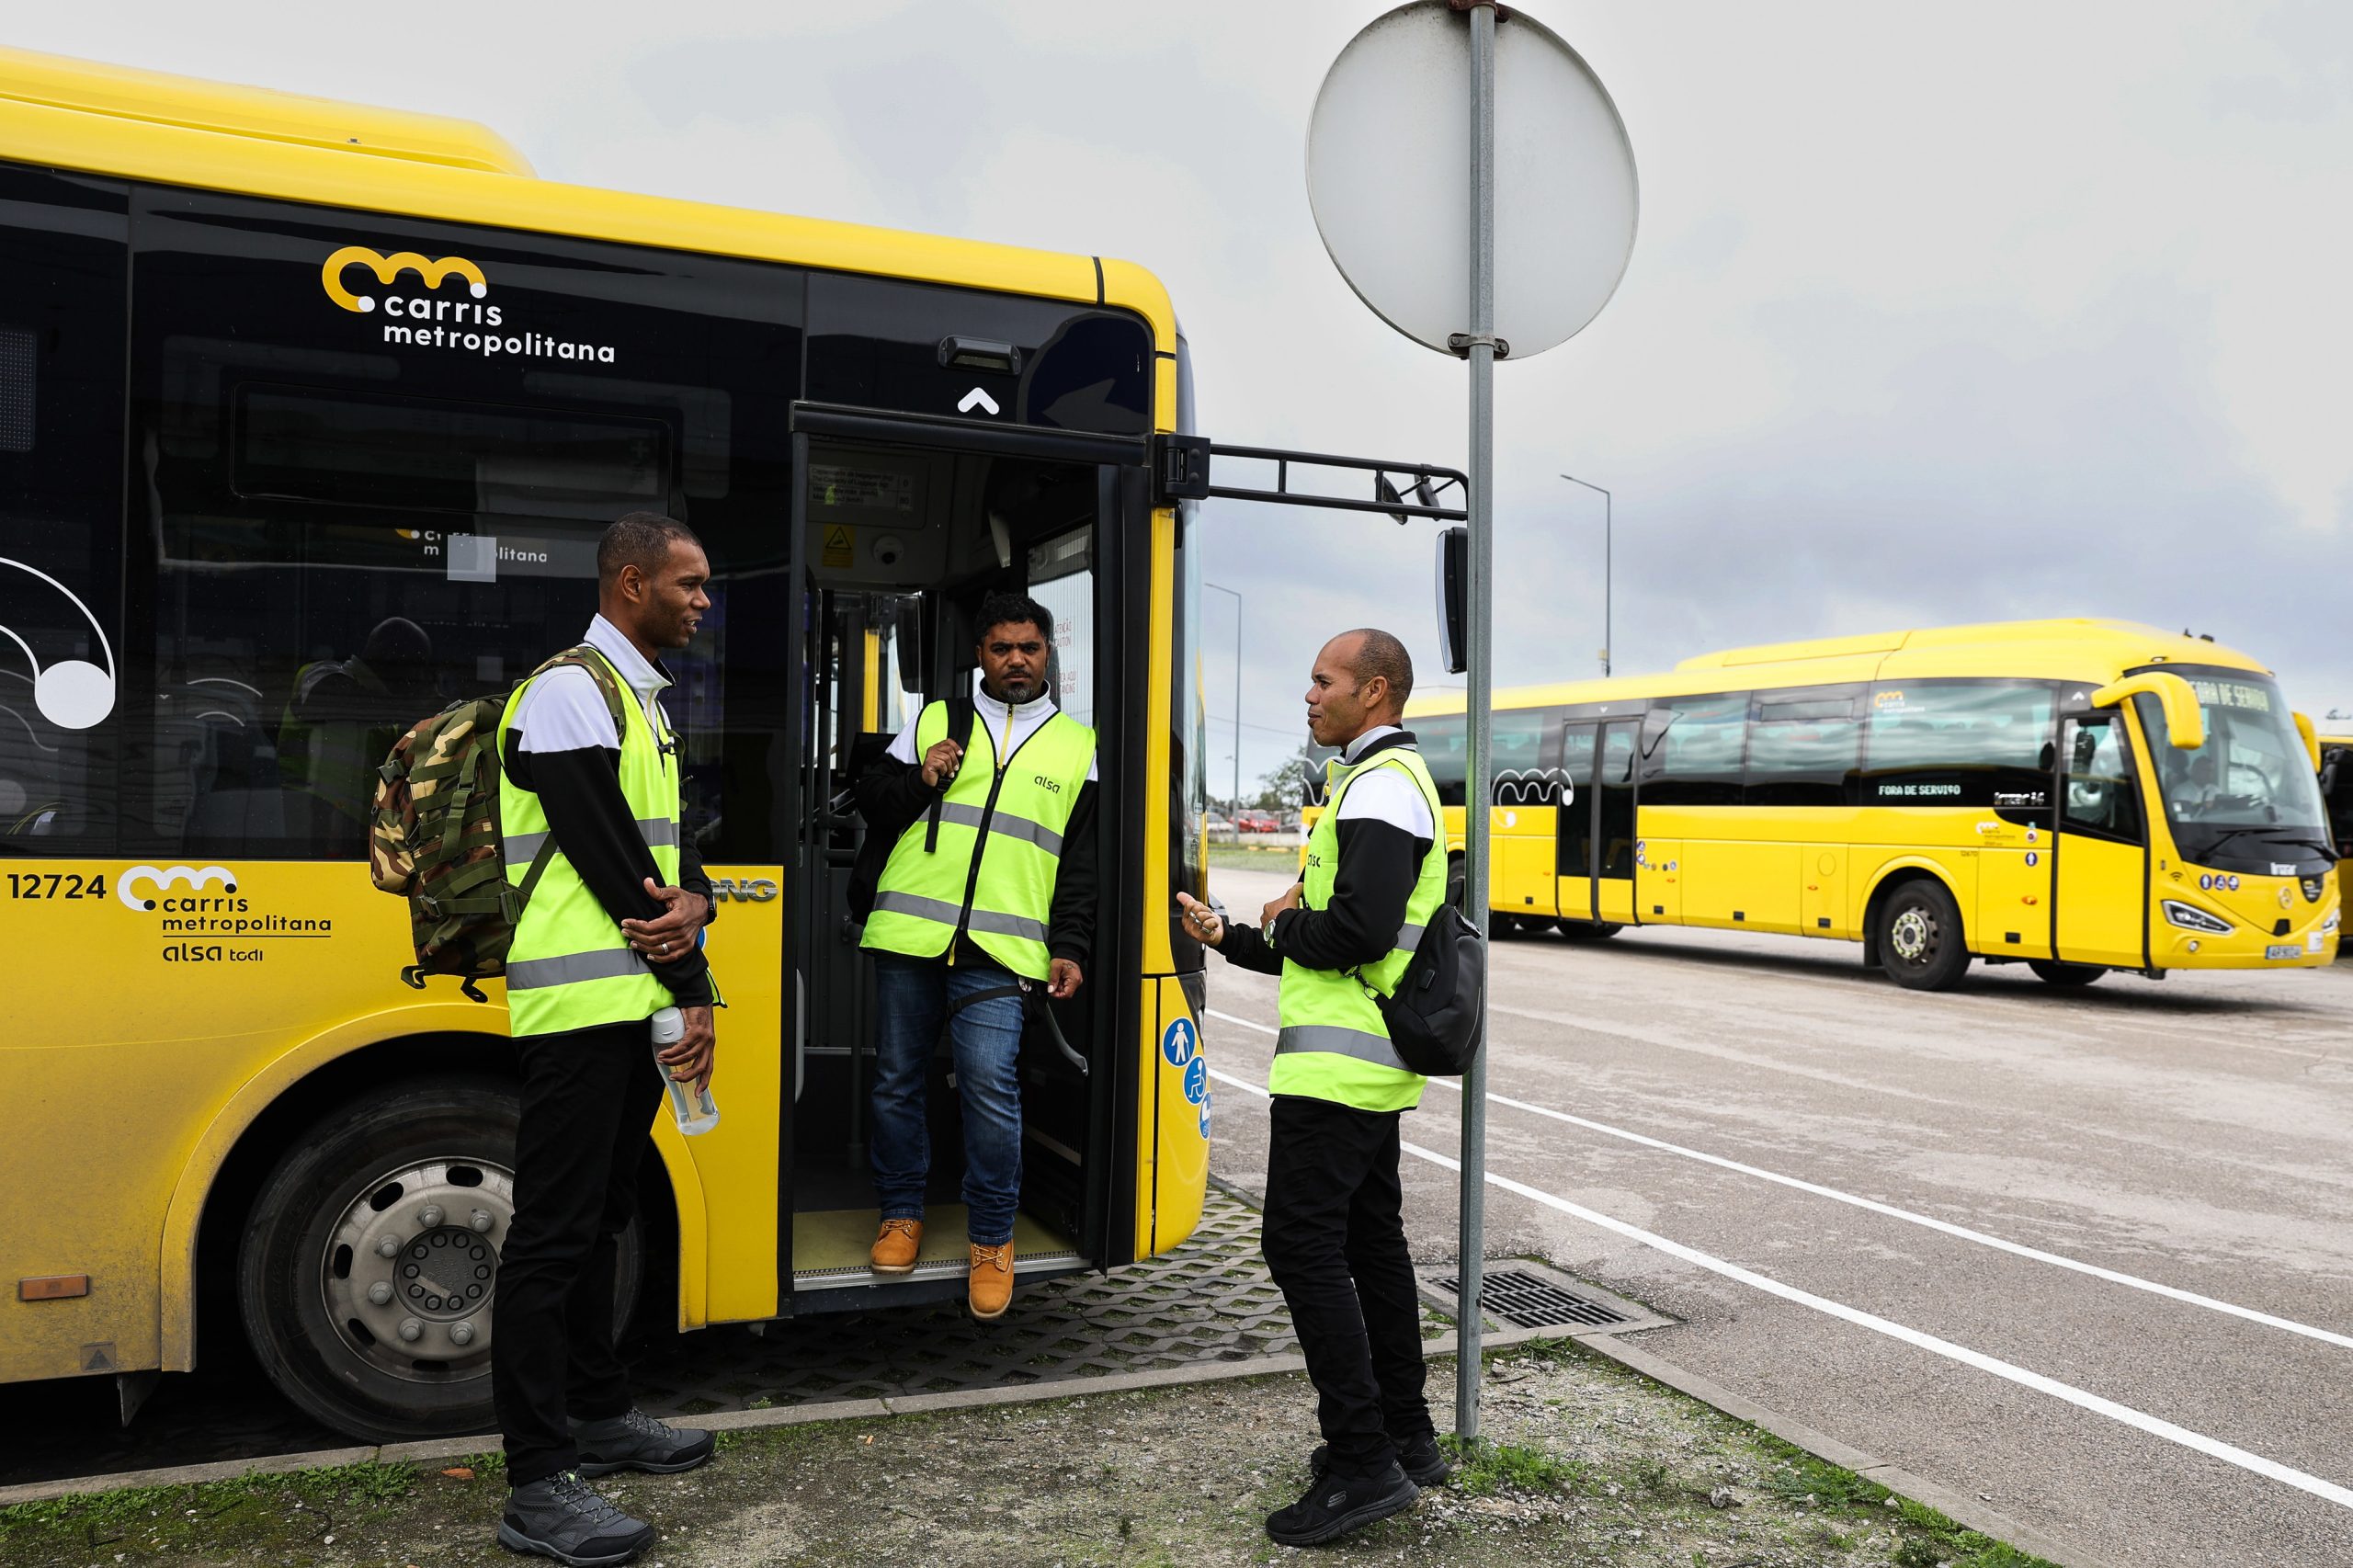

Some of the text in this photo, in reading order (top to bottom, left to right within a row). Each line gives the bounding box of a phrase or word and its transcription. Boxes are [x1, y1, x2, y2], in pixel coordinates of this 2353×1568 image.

[384, 295, 503, 326] carris
[383, 325, 615, 363] metropolitana
[424, 545, 548, 562] mlitana
[1034, 776, 1061, 794] alsa
[1878, 785, 1904, 796] FORA
[1904, 785, 1917, 795] DE
[7, 874, 107, 899] 12724
[163, 897, 249, 913] carris
[162, 915, 332, 934] metropolitana
[163, 942, 222, 962] alsa
